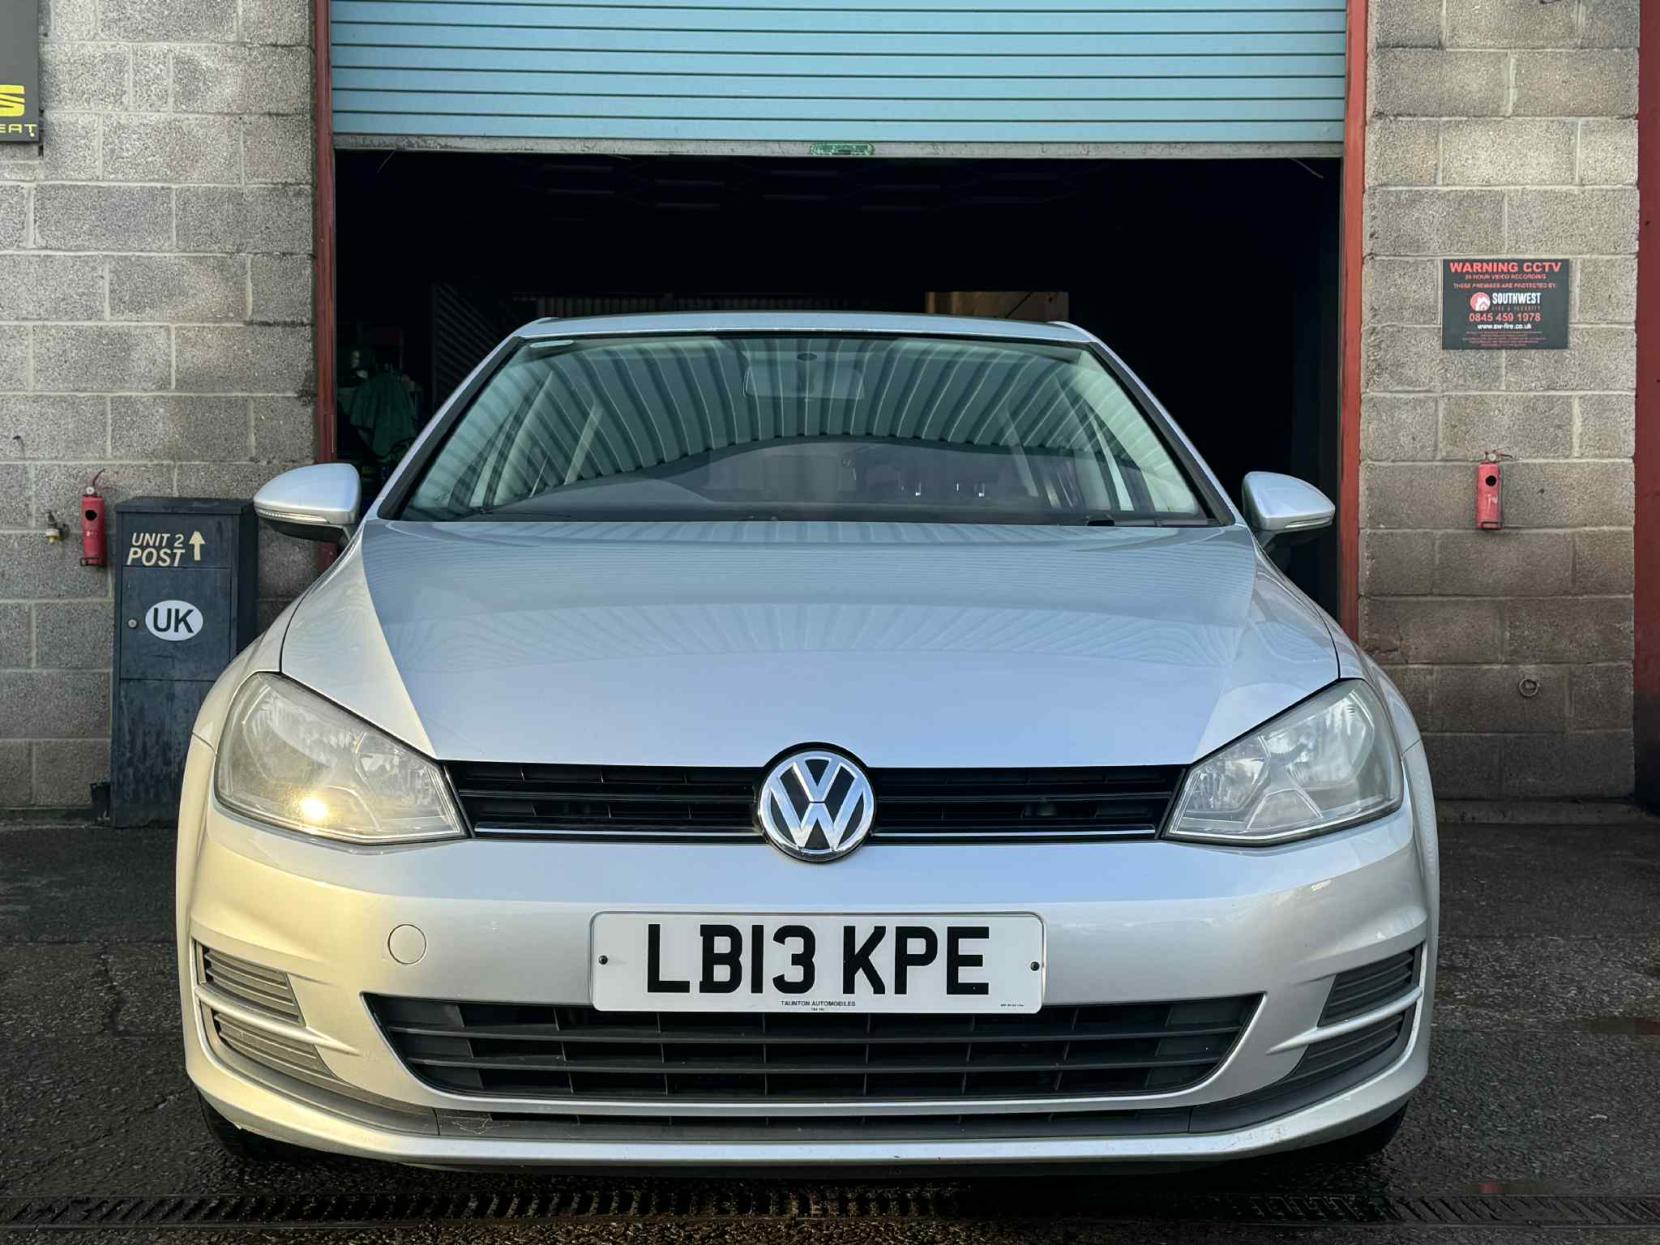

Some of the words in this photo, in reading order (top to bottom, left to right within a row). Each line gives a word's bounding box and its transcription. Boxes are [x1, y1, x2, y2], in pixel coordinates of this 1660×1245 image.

[1449, 262, 1519, 273] WARNING
[1523, 262, 1562, 273] CCTV
[1492, 292, 1542, 304] SOUTHWEST
[1469, 312, 1493, 322] 0845
[1495, 312, 1514, 322] 459
[131, 532, 171, 546] UNIT
[173, 533, 184, 547] 2
[126, 547, 185, 567] POST
[153, 607, 194, 633] UK
[647, 923, 816, 994] LB13
[842, 925, 990, 995] KPE
